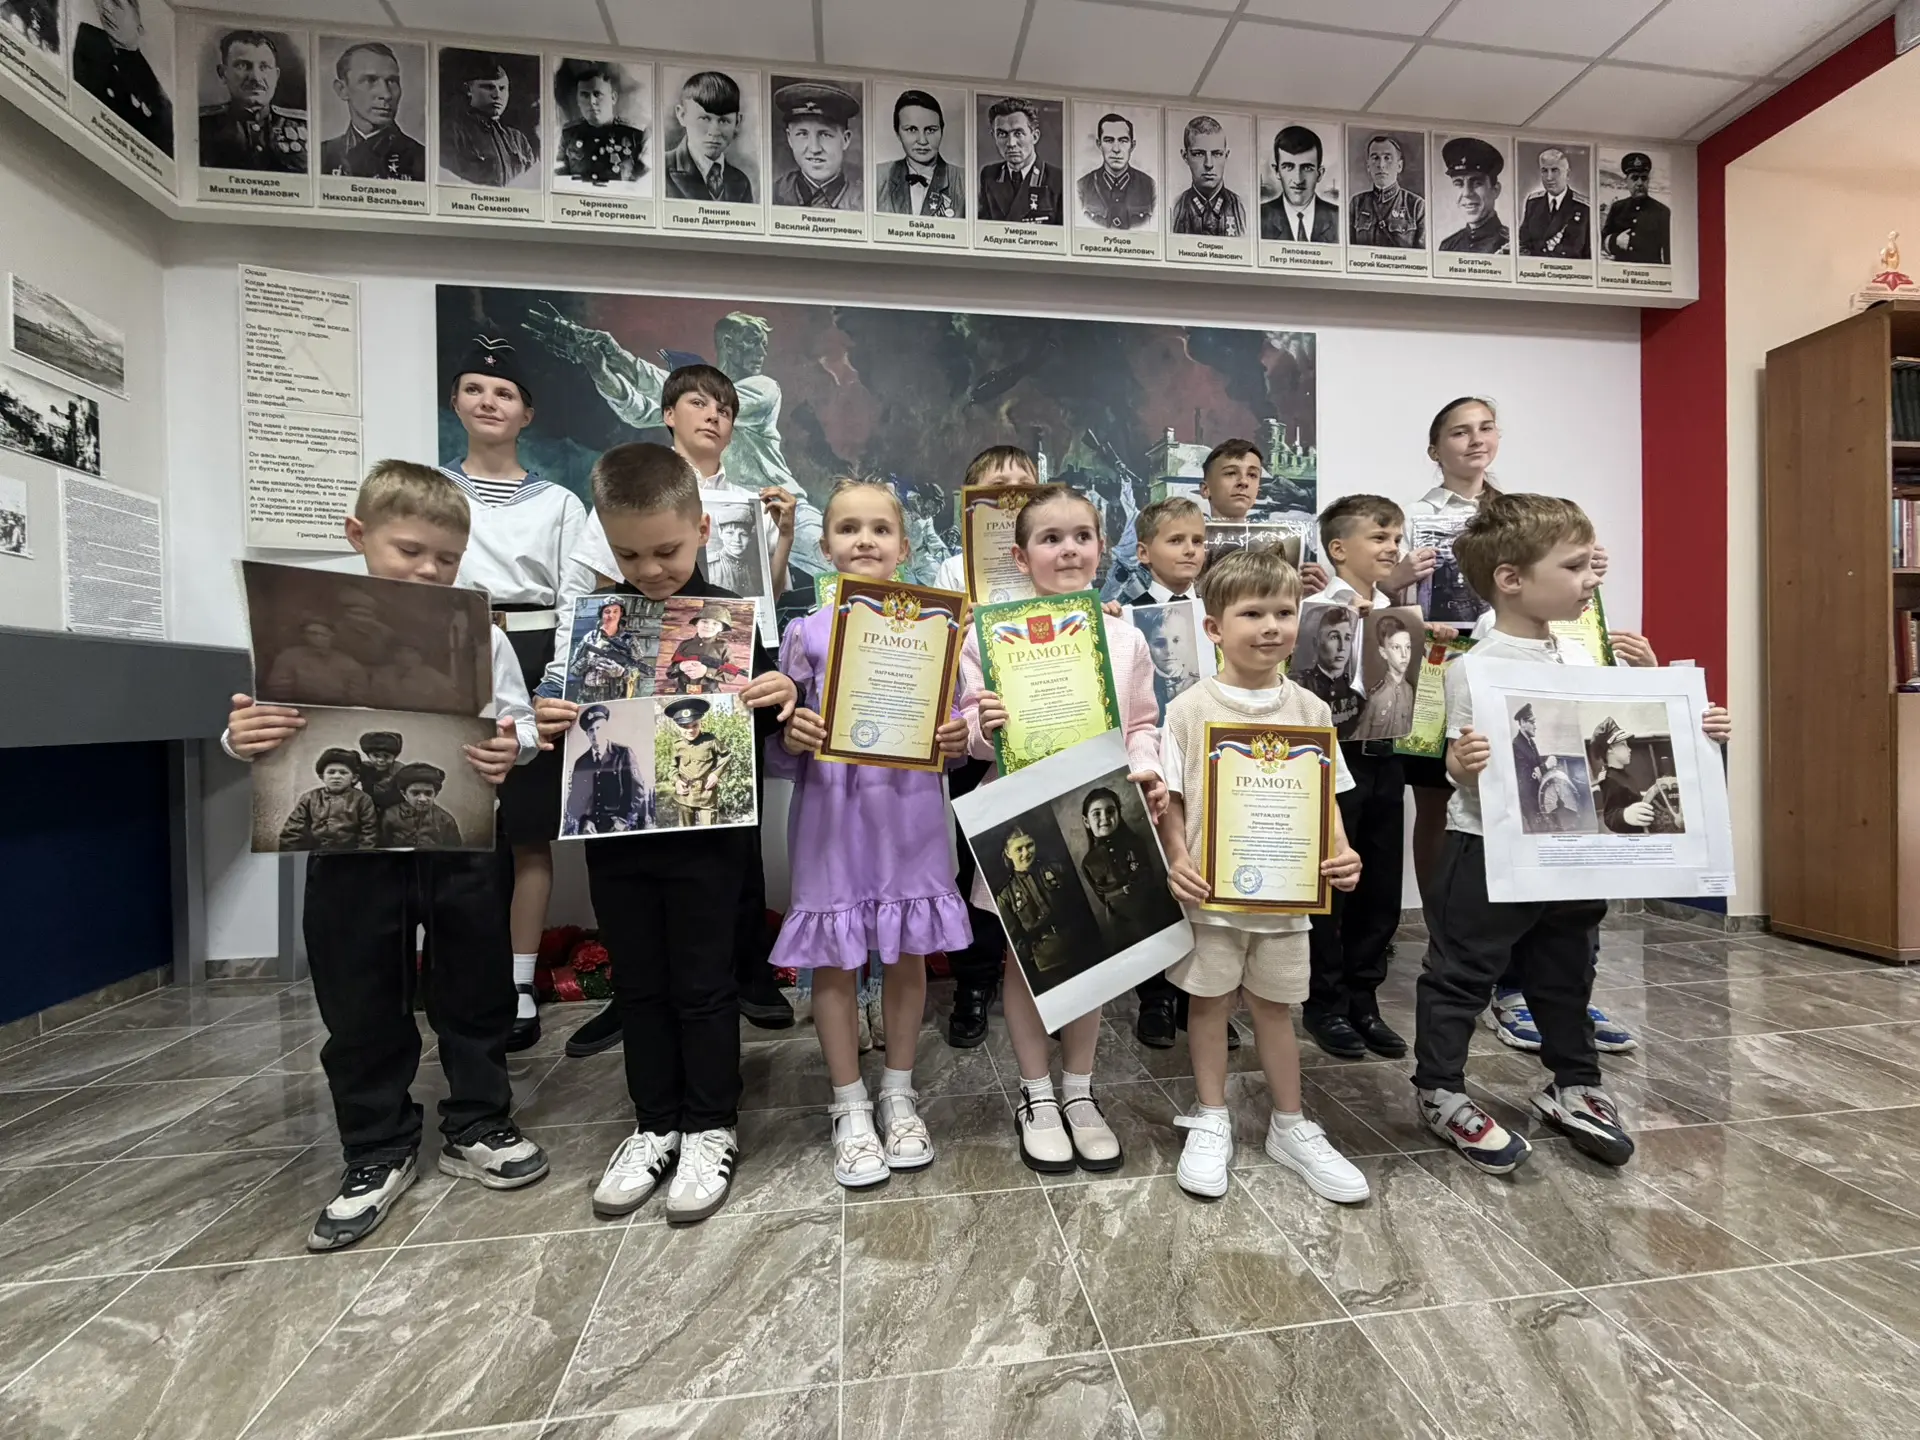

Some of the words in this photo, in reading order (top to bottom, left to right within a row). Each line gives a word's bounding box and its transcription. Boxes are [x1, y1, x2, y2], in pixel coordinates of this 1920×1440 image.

[229, 176, 280, 186] Гахокидзе
[210, 185, 248, 195] Михаил
[251, 188, 299, 198] Иванович
[351, 184, 397, 194] Богданов
[322, 193, 364, 203] Николай
[367, 196, 425, 207] Васильевич
[471, 193, 510, 202] Пьянзин
[451, 202, 475, 211] Иван
[477, 204, 530, 213] Семенович
[579, 199, 628, 209] Черниенко
[561, 208, 592, 217] Гергий
[595, 210, 646, 220] Георгиевич
[698, 207, 730, 216] Линник
[673, 215, 700, 224] Павел
[702, 217, 756, 227] Дмитриевич
[802, 214, 836, 223] Ревякин
[775, 222, 810, 232] Василий
[812, 225, 862, 235] Дмитриевич
[909, 221, 934, 229] Байда
[888, 228, 914, 237] Мария
[917, 231, 955, 240] Карповна
[1005, 227, 1037, 236] Умеркин
[984, 235, 1016, 245] Абдулак
[1018, 237, 1058, 246] Сагитович
[1104, 236, 1131, 245] Рубцов
[1081, 244, 1111, 254] Герасим
[1113, 246, 1154, 256] Архипович
[1197, 242, 1223, 250] Спирин
[1179, 249, 1207, 258] Николай
[1209, 251, 1243, 260] Иванович
[1371, 252, 1407, 261] Главацкий
[1270, 256, 1287, 265] Петр
[1290, 257, 1333, 266] Николаевич
[1350, 260, 1375, 269] Георгий
[1376, 261, 1428, 271] Константинович
[1459, 258, 1492, 267] Богатырь
[1449, 266, 1466, 274] Иван
[1468, 267, 1501, 275] Иванович
[1601, 276, 1629, 284] Николай
[863, 632, 928, 651] ГРАМОТА
[1007, 643, 1082, 664] ГРАМОТА
[1236, 776, 1302, 789] ГРАМОТА
